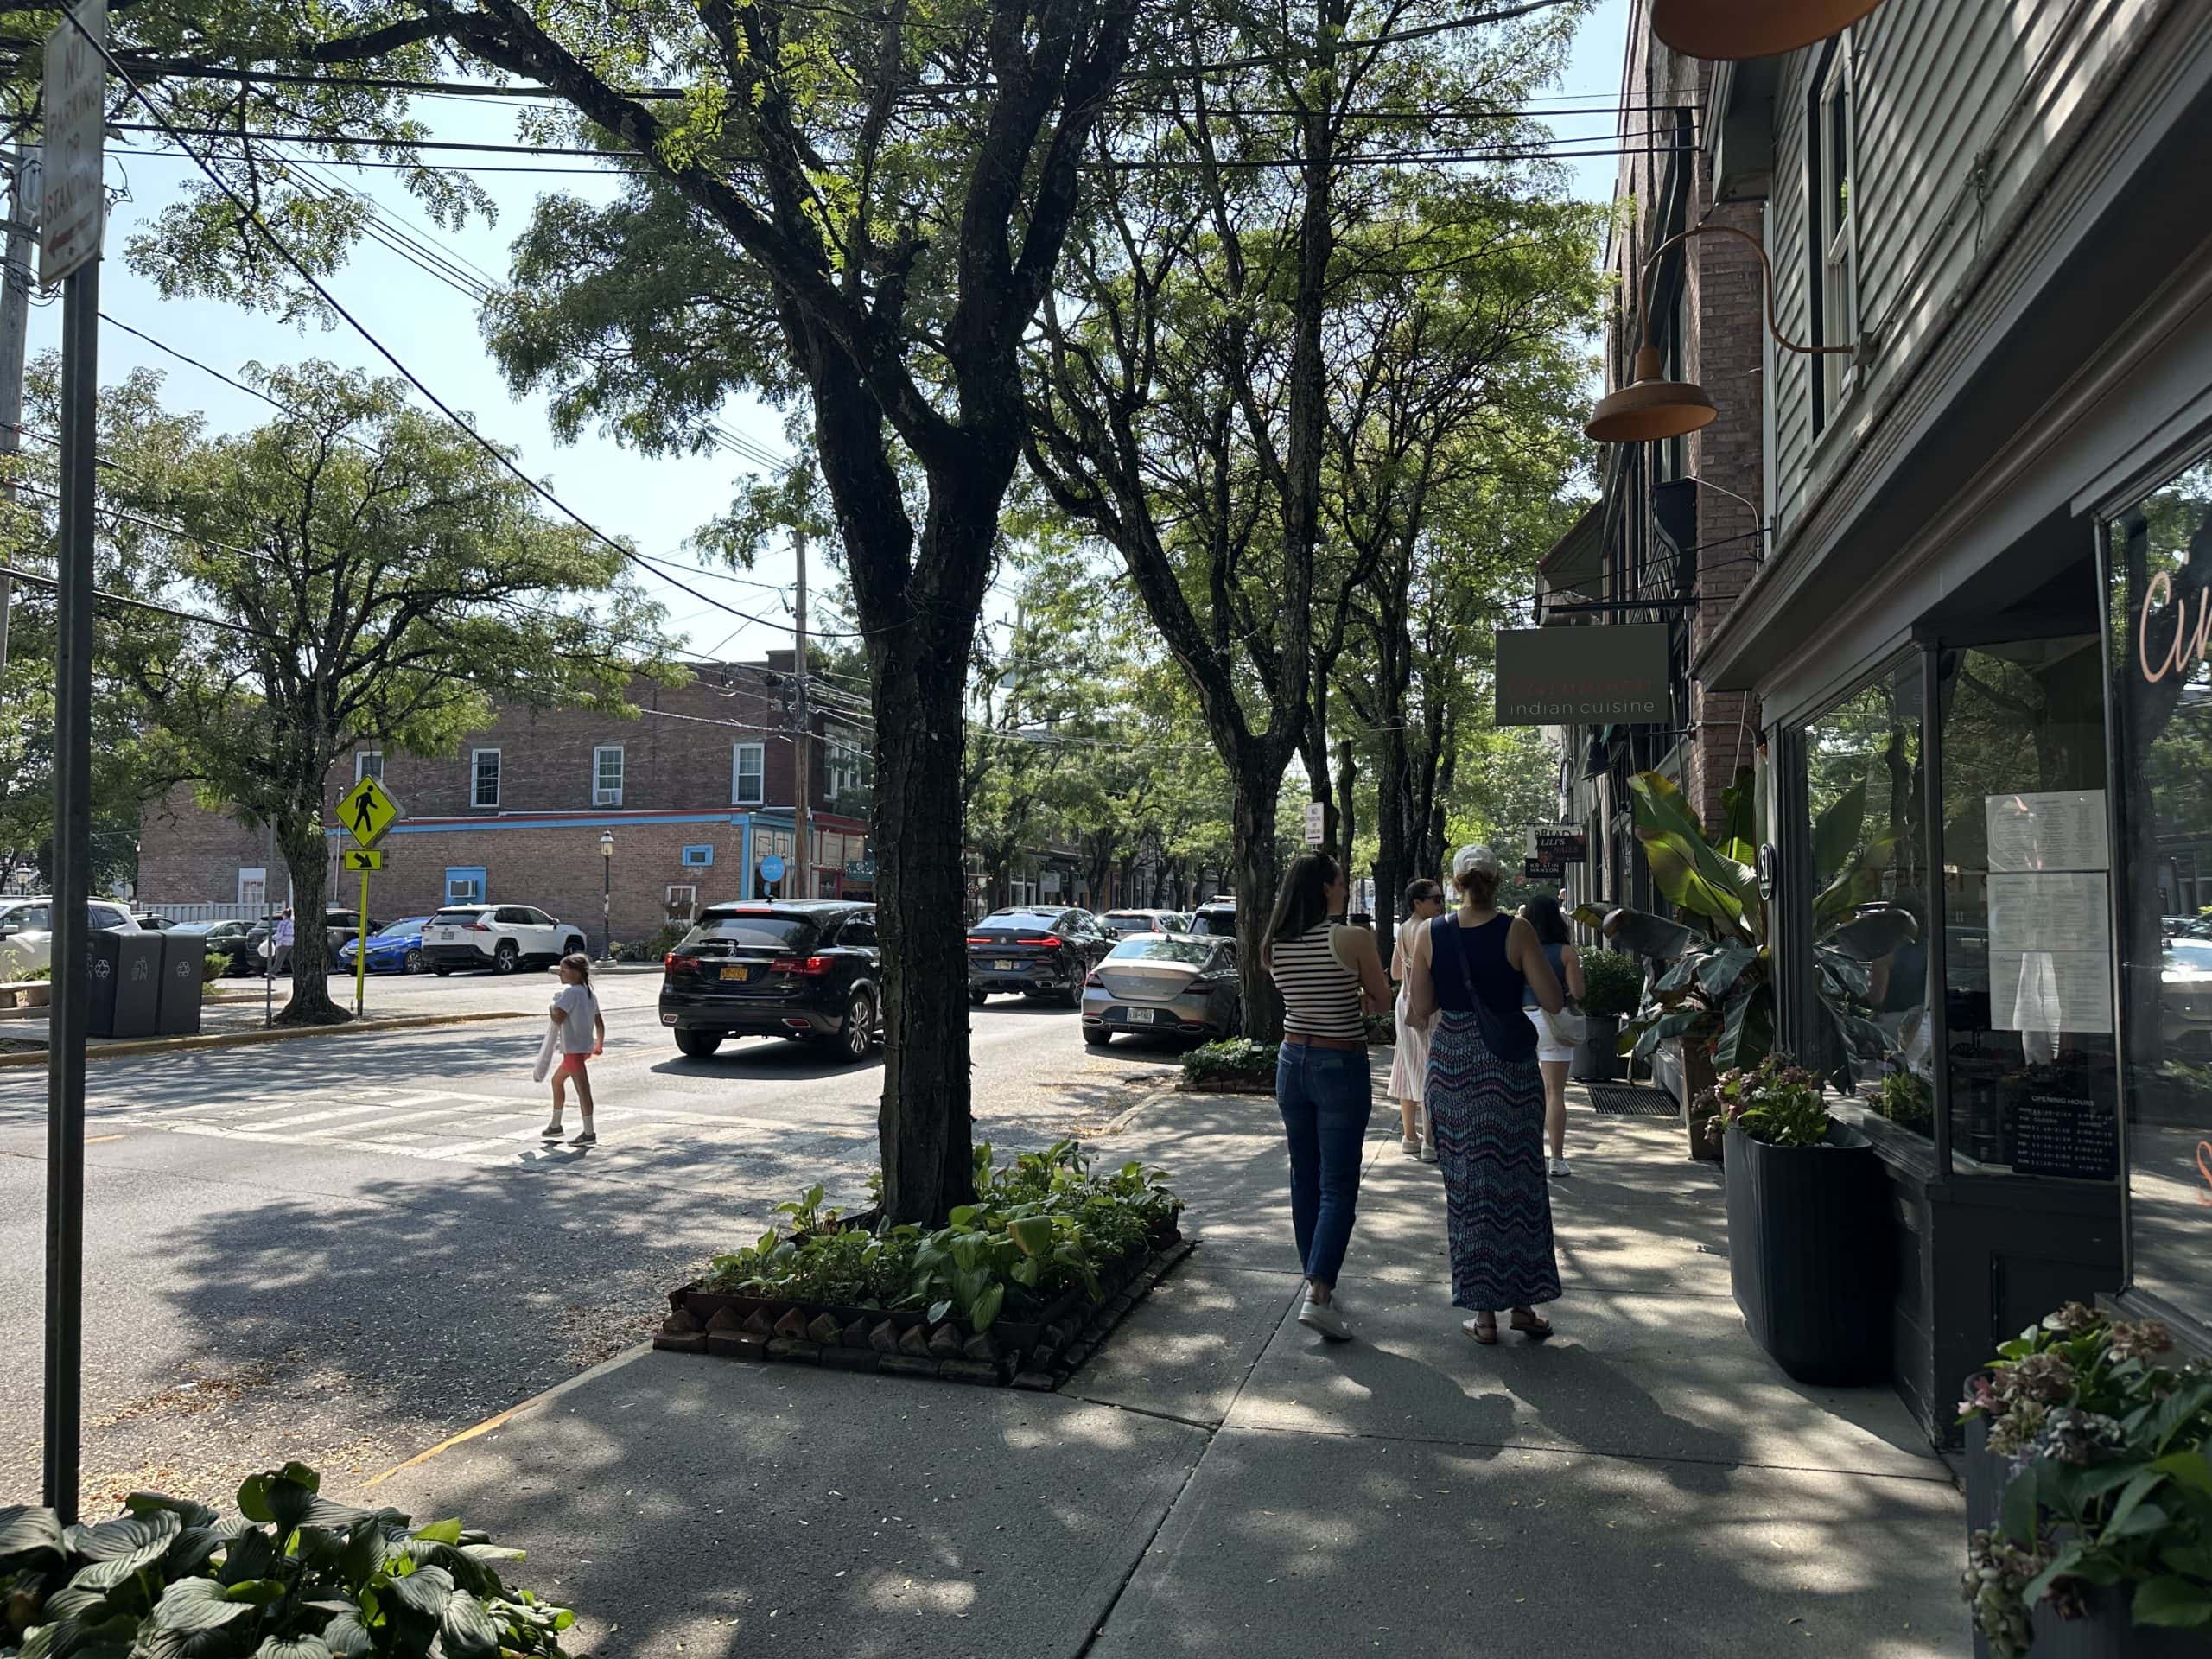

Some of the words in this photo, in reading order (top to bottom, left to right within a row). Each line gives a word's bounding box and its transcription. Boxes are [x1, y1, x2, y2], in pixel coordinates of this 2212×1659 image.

[65, 40, 85, 90] NO
[48, 75, 99, 145] PARKING
[66, 132, 80, 172] OR
[46, 162, 98, 225] STANDING
[1510, 701, 1573, 716] indian
[1580, 700, 1655, 715] cuisine
[1761, 849, 1769, 881] 51
[2031, 1095, 2066, 1104] OPENING
[2067, 1098, 2095, 1107] HOURS
